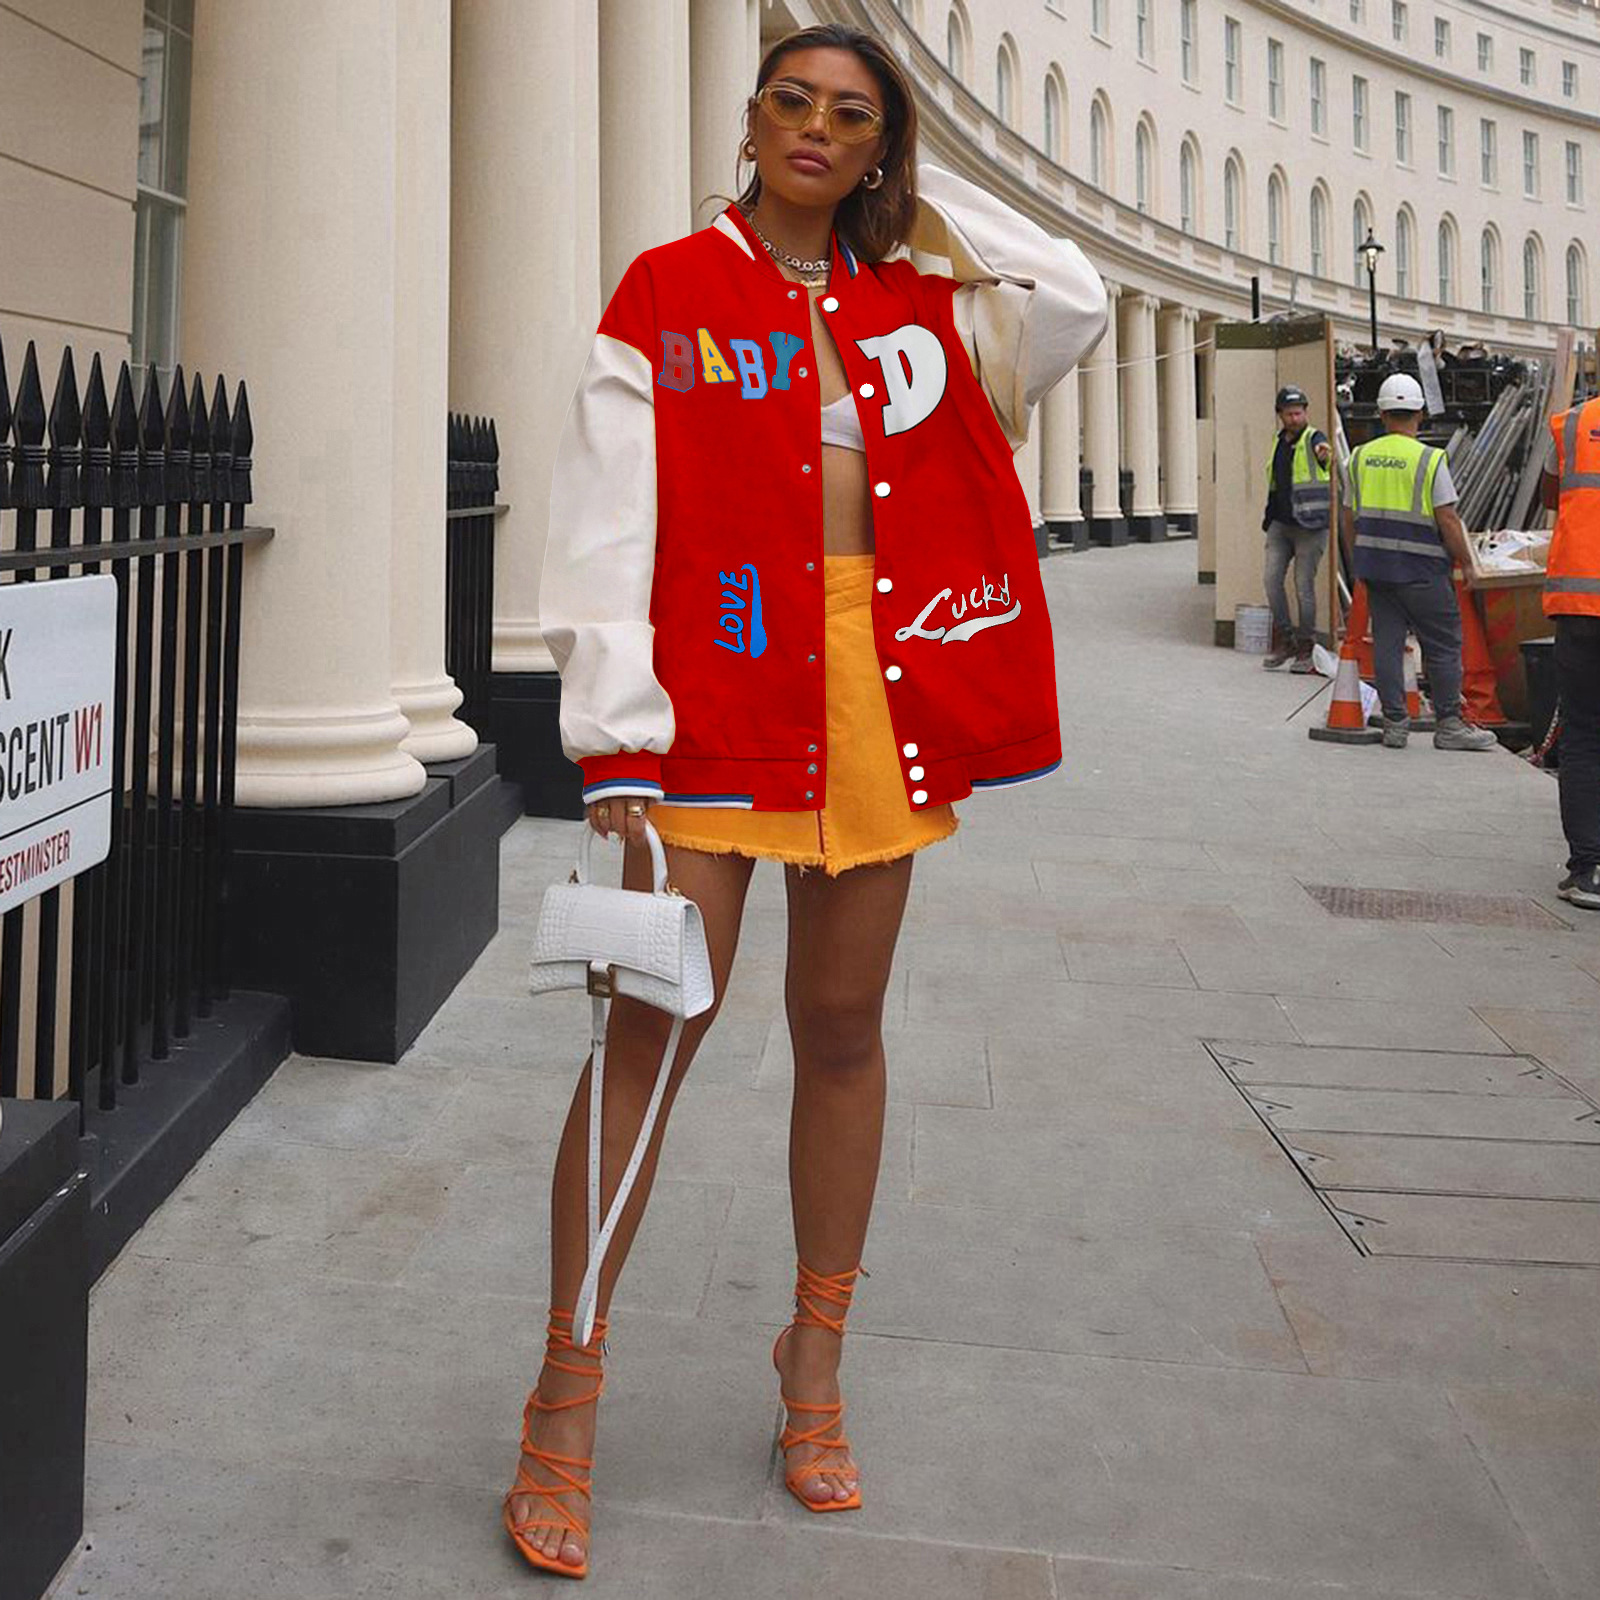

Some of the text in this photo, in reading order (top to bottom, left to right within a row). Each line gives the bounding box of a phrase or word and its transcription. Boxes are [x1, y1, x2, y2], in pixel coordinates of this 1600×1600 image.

[657, 328, 805, 399] BABY
[853, 323, 948, 438] D
[1365, 457, 1407, 470] MIDGARD
[713, 570, 748, 654] LOVE
[75, 702, 103, 774] W1
